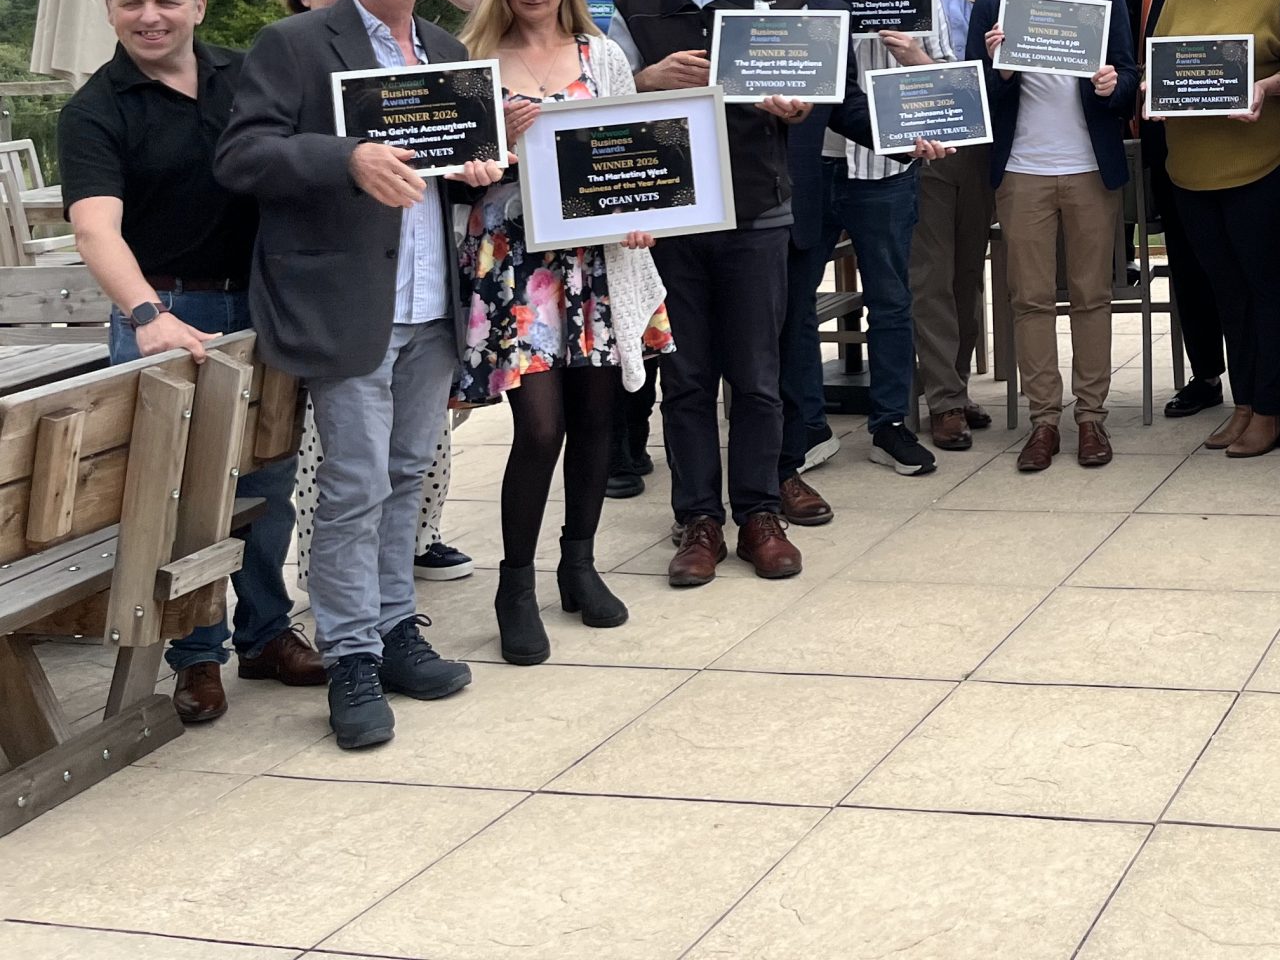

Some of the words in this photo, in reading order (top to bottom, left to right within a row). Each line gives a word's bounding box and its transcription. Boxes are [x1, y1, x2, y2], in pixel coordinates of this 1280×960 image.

[749, 49, 786, 57] WINNER
[1032, 52, 1064, 62] LOWMAN
[1064, 56, 1088, 64] VOCALS
[381, 88, 429, 100] Business
[383, 97, 421, 108] Awards
[902, 100, 934, 109] WINNER
[383, 113, 430, 124] WINNER
[433, 109, 458, 120] 2026
[368, 129, 387, 138] The
[389, 125, 418, 136] Gervis
[904, 129, 942, 138] EXECUTIVE
[942, 126, 968, 134] TRAVEL
[409, 136, 441, 144] Business
[442, 132, 466, 141] Award
[591, 137, 633, 148] Business
[429, 147, 454, 158] VETS
[592, 146, 626, 155] Awards
[592, 160, 634, 171] WINNER
[637, 157, 659, 167] 2026
[588, 174, 604, 182] The
[605, 170, 646, 181] Marketing
[579, 186, 612, 194] Business
[656, 176, 680, 186] Award
[599, 195, 632, 206] OCEAN
[634, 192, 660, 202] VETS
